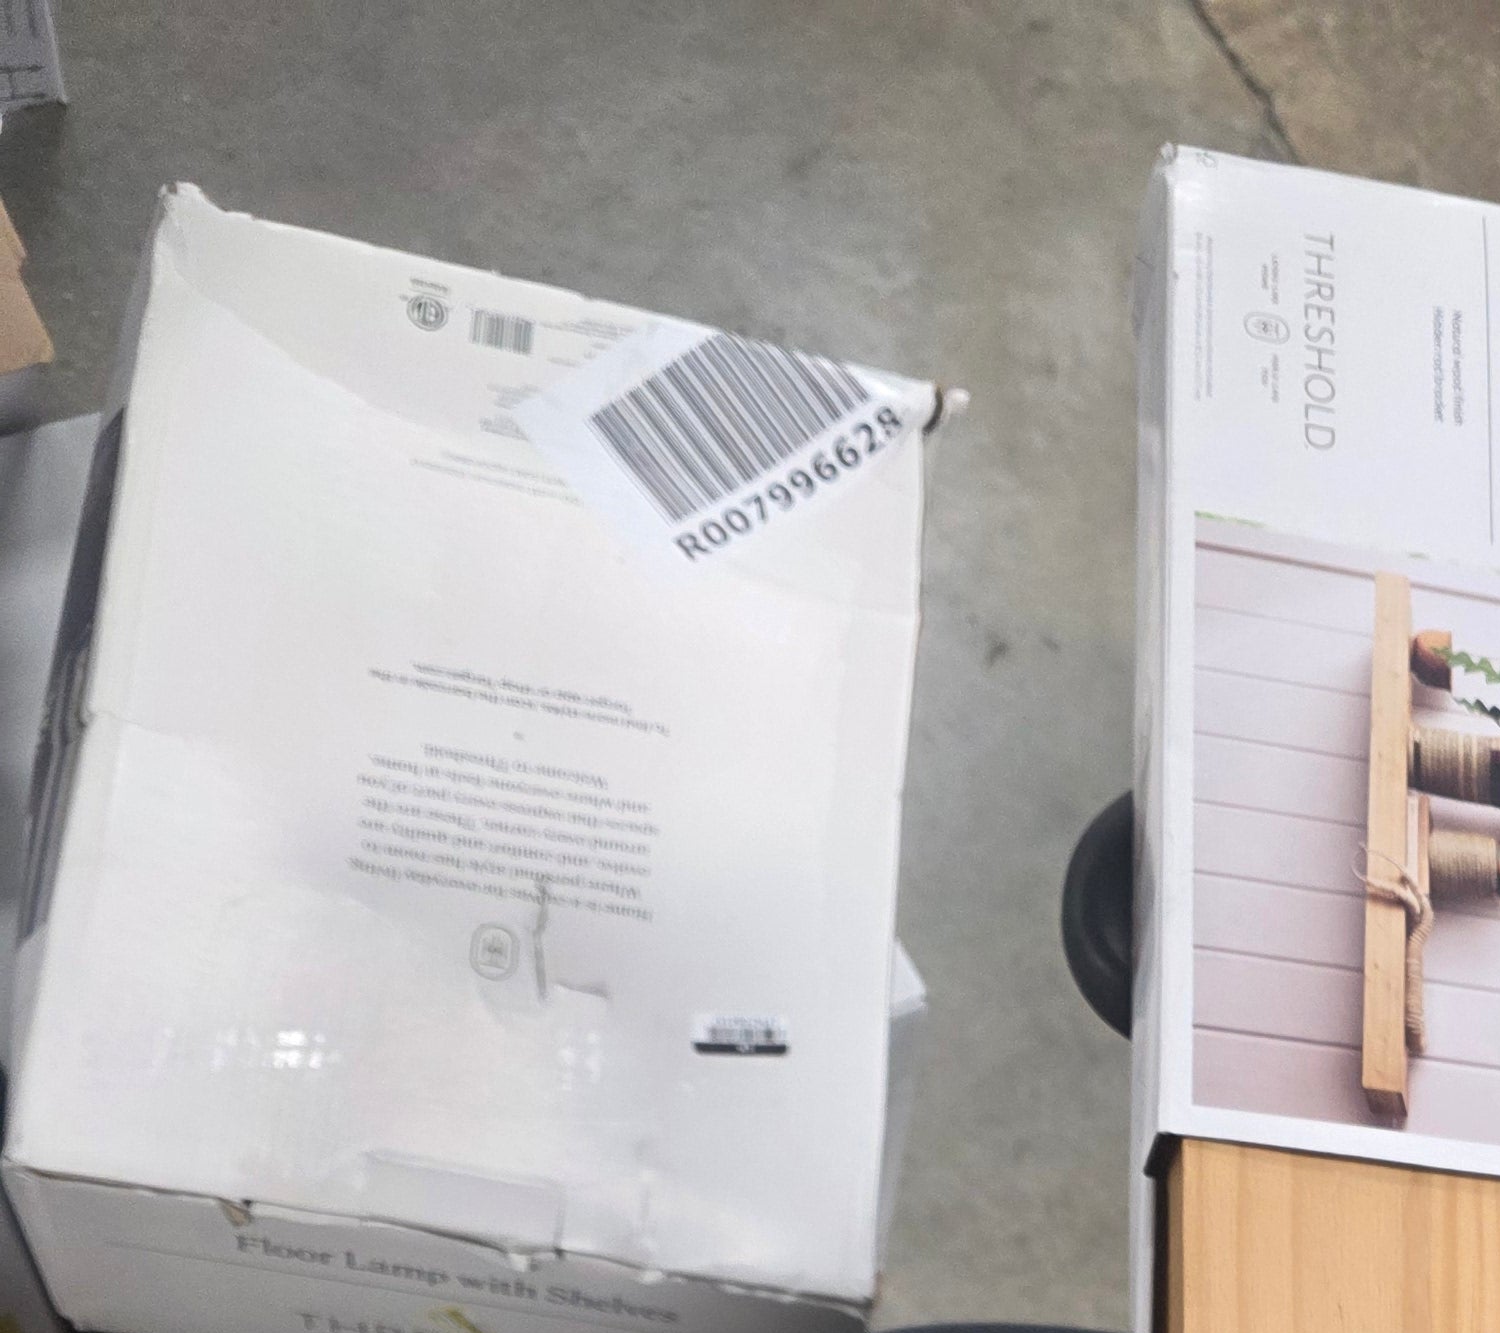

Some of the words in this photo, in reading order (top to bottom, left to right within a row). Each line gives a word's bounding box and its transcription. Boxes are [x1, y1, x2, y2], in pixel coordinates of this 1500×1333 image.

[1303, 233, 1336, 450] THRESHOLD
[673, 405, 901, 562] R007996628
[234, 1232, 334, 1266] Floor
[343, 1250, 450, 1287] Lamp
[455, 1272, 538, 1300] with
[544, 1284, 681, 1324] Shelves
